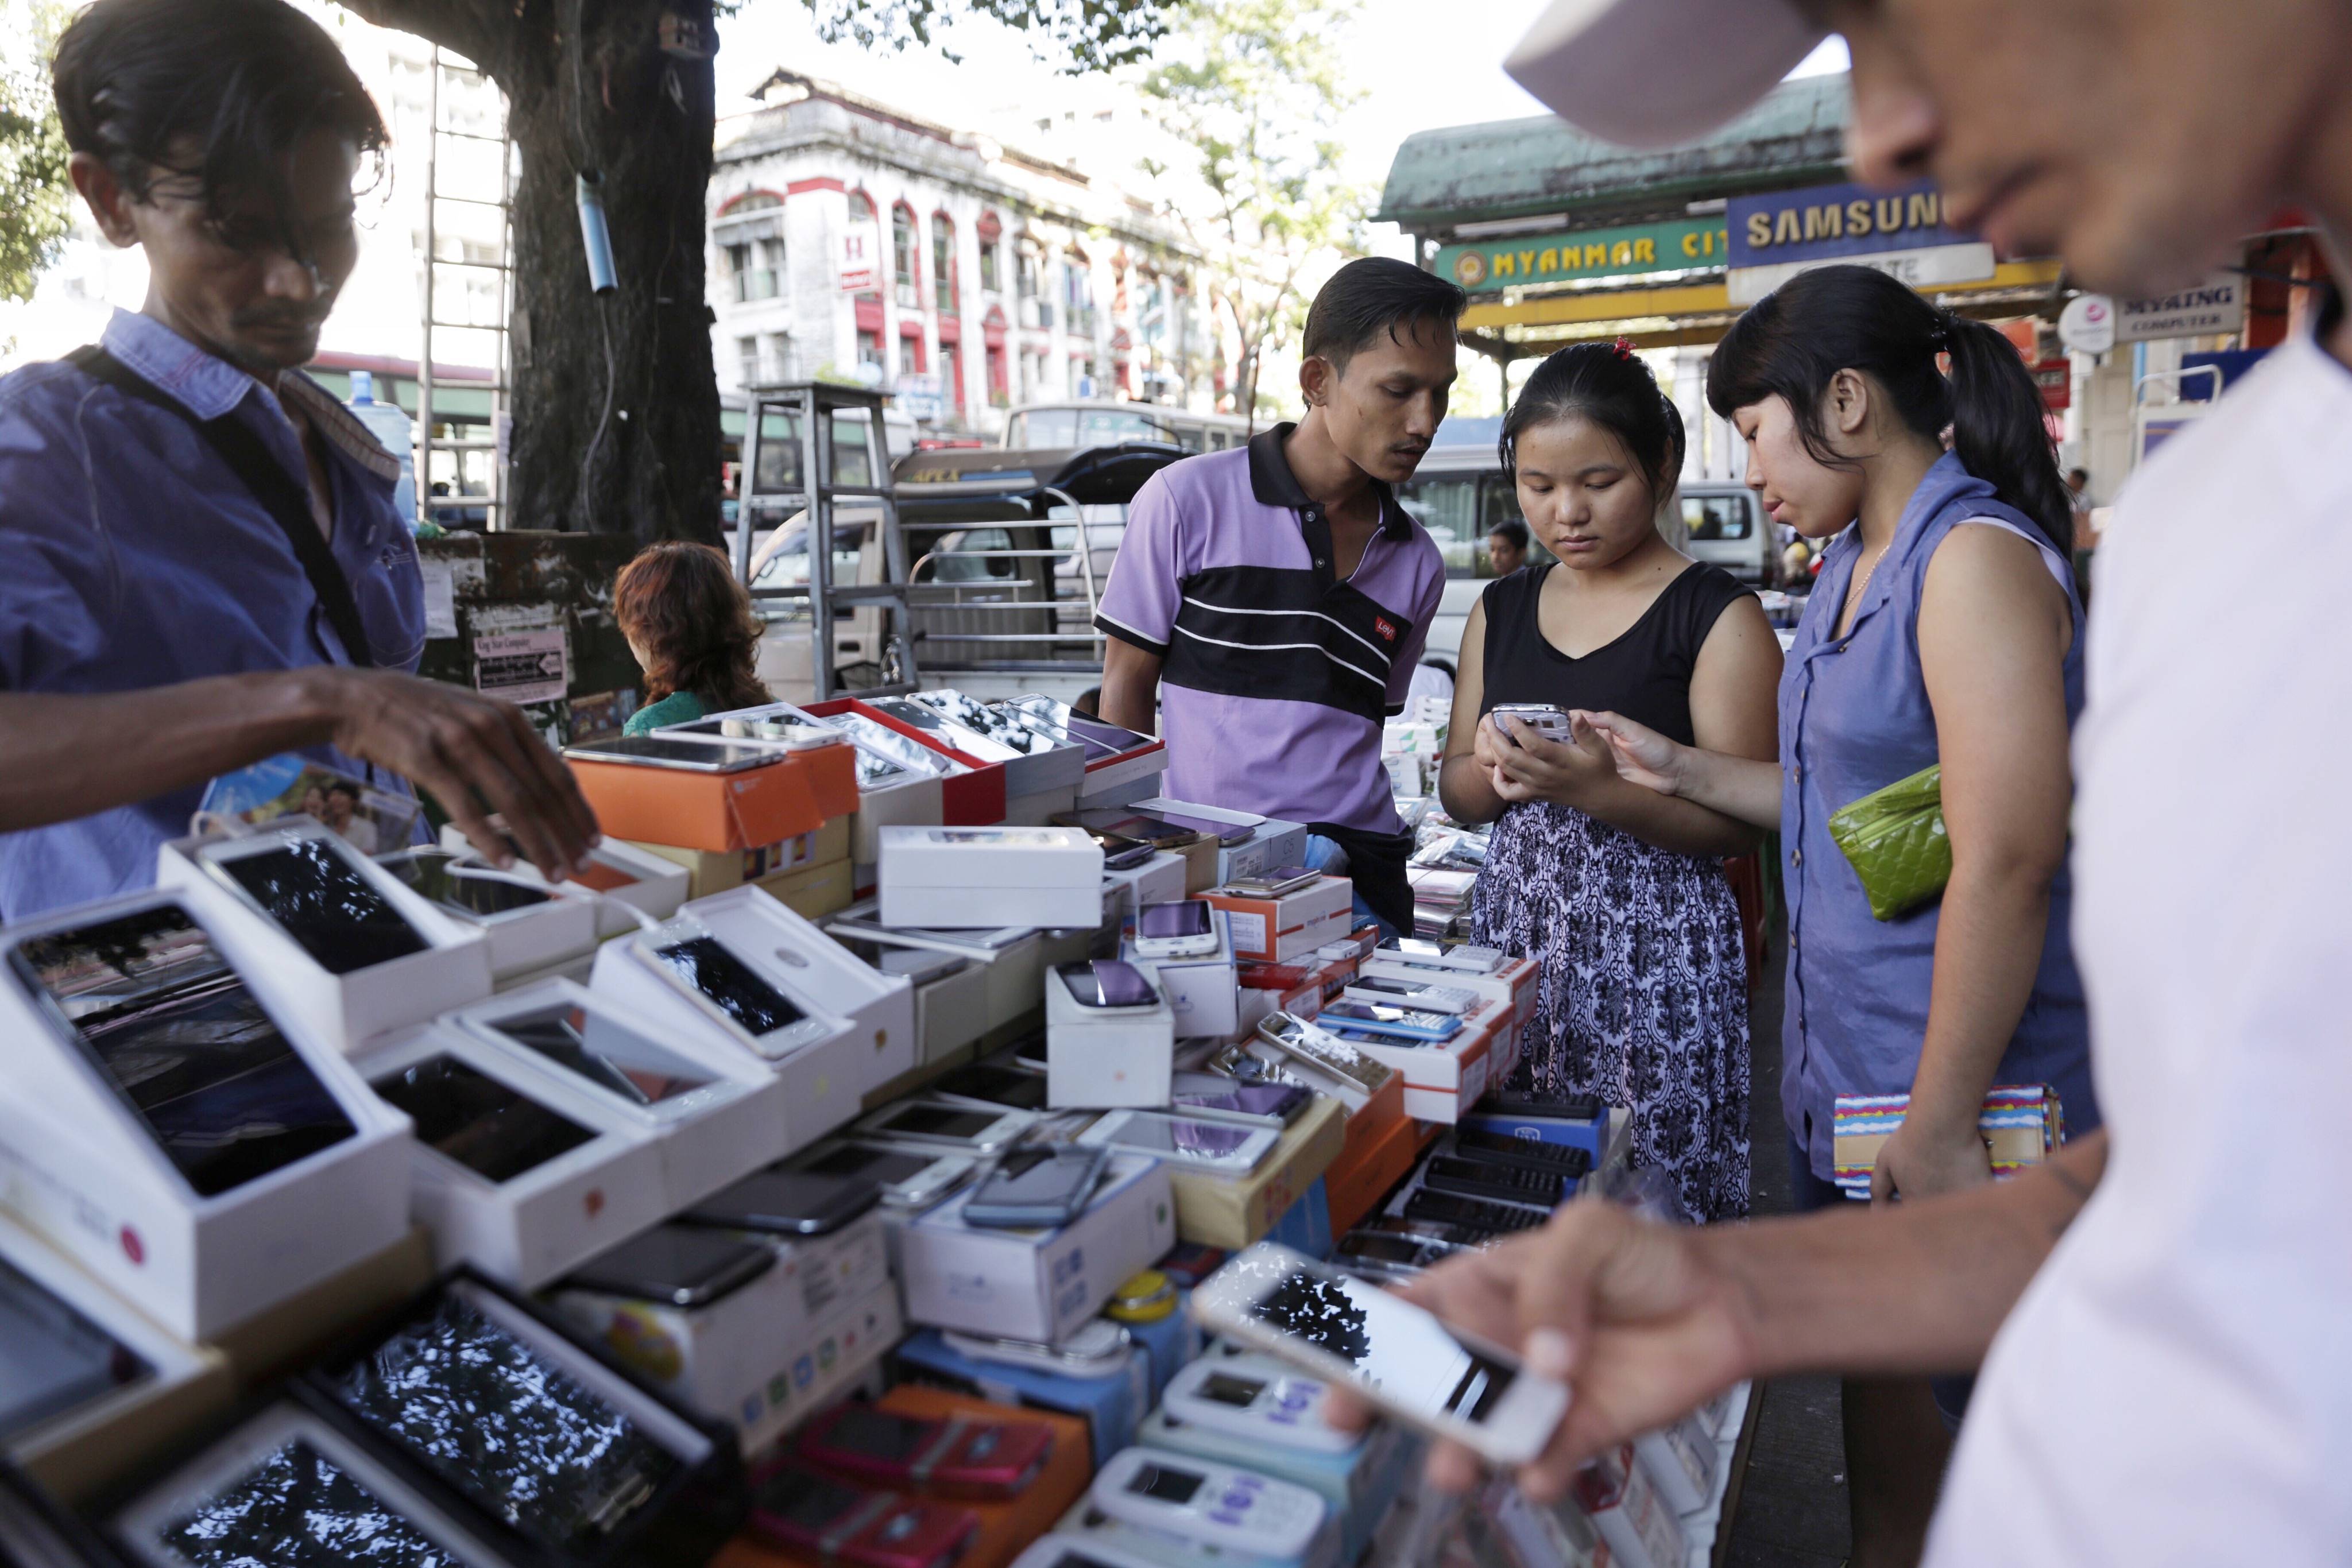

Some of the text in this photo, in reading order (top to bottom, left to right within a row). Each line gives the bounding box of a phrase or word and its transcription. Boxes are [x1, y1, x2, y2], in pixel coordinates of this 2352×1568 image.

[1747, 192, 1947, 249] SAMSUN
[1493, 237, 1655, 277] MYANMAR
[2131, 313, 2222, 332] COMPUTER
